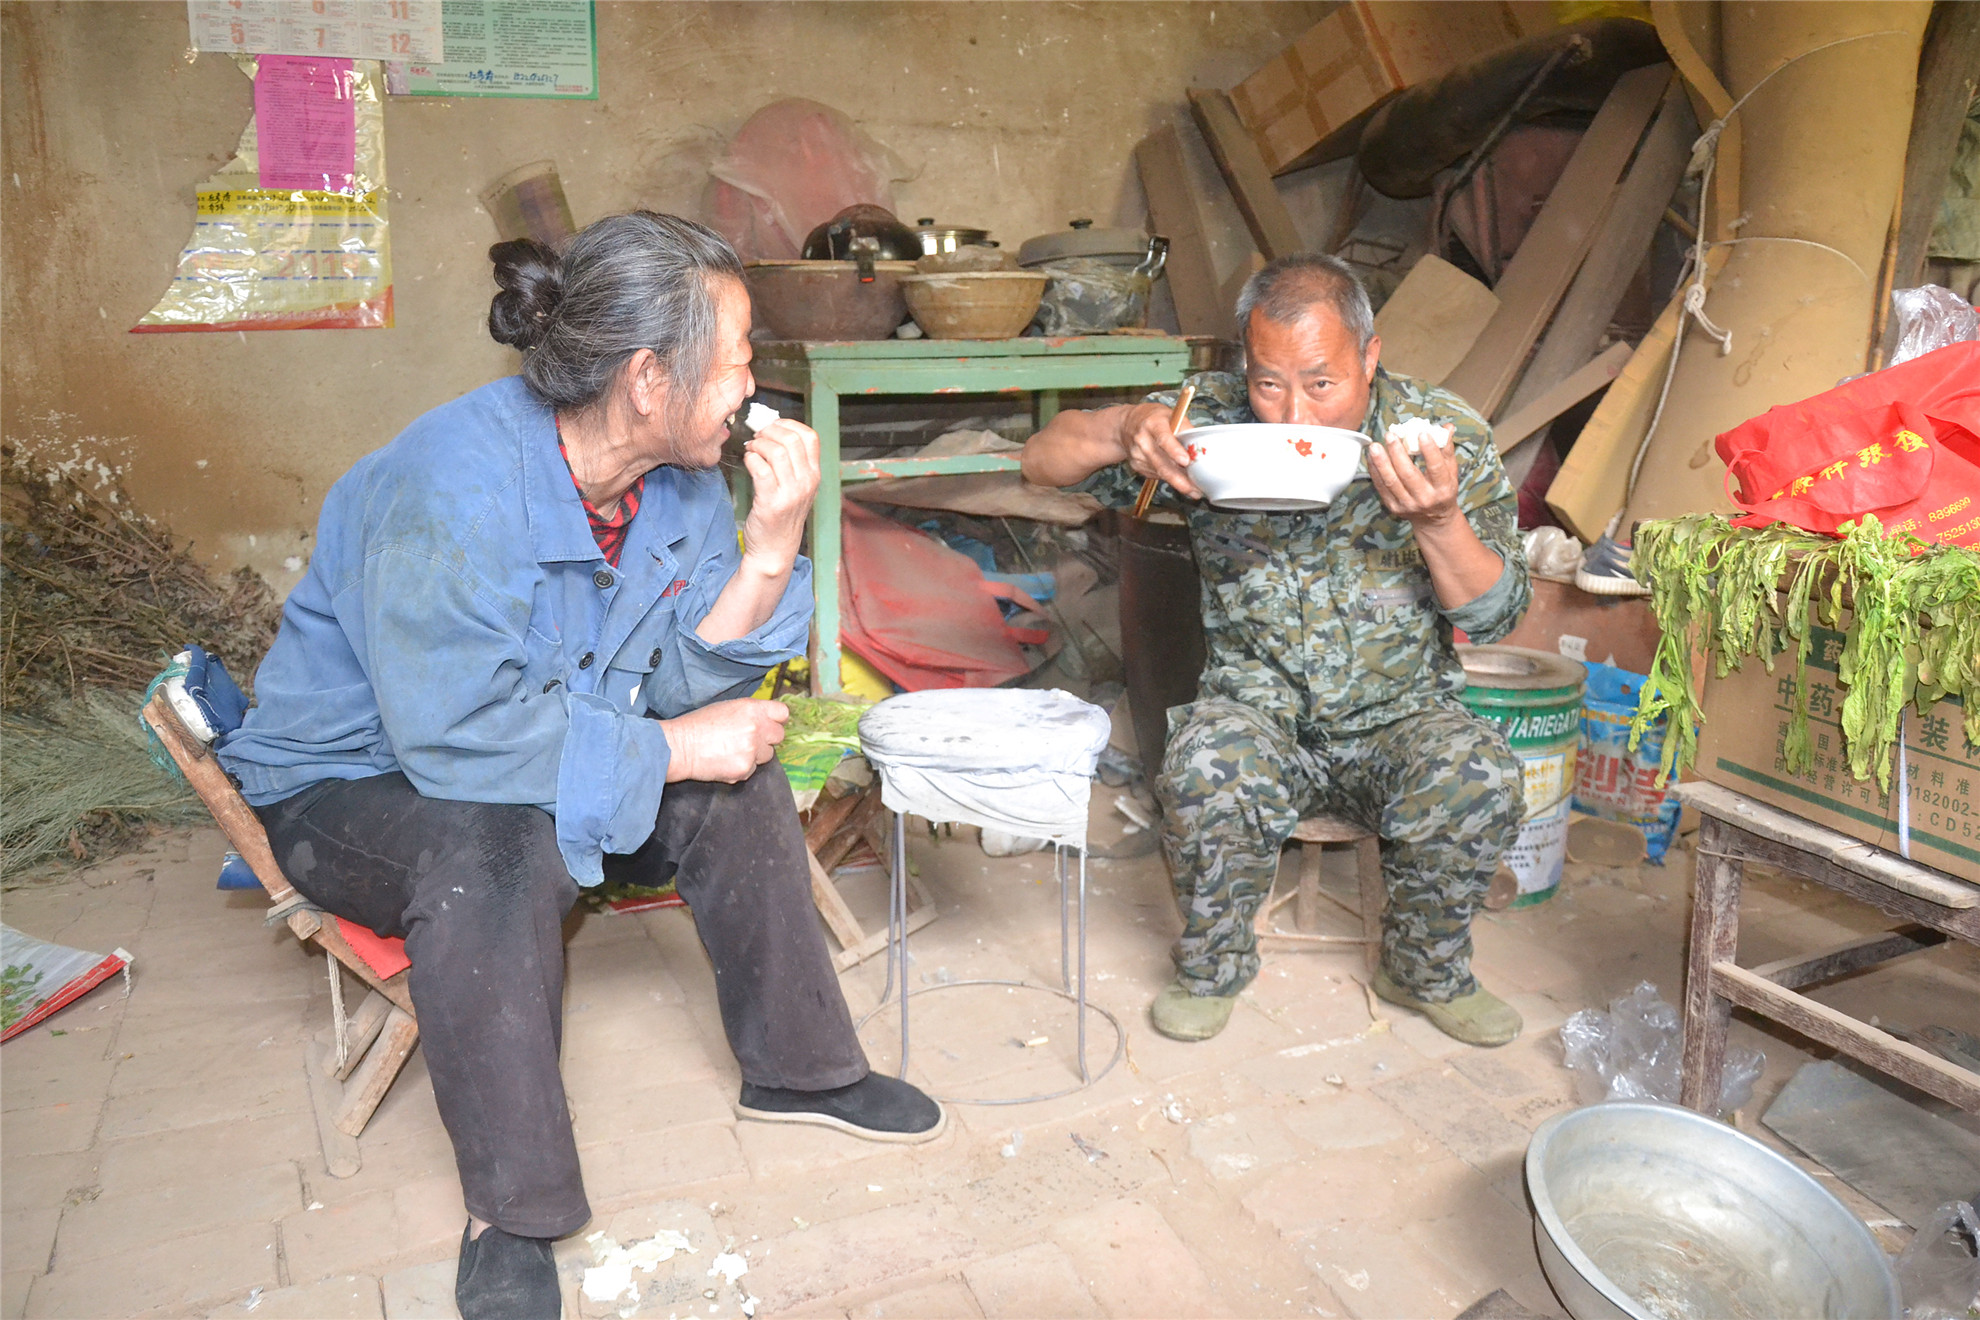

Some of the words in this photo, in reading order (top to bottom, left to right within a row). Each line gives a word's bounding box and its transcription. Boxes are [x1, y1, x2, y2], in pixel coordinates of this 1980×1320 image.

[230, 22, 245, 44] 5
[313, 28, 326, 48] 7
[388, 33, 411, 54] 12
